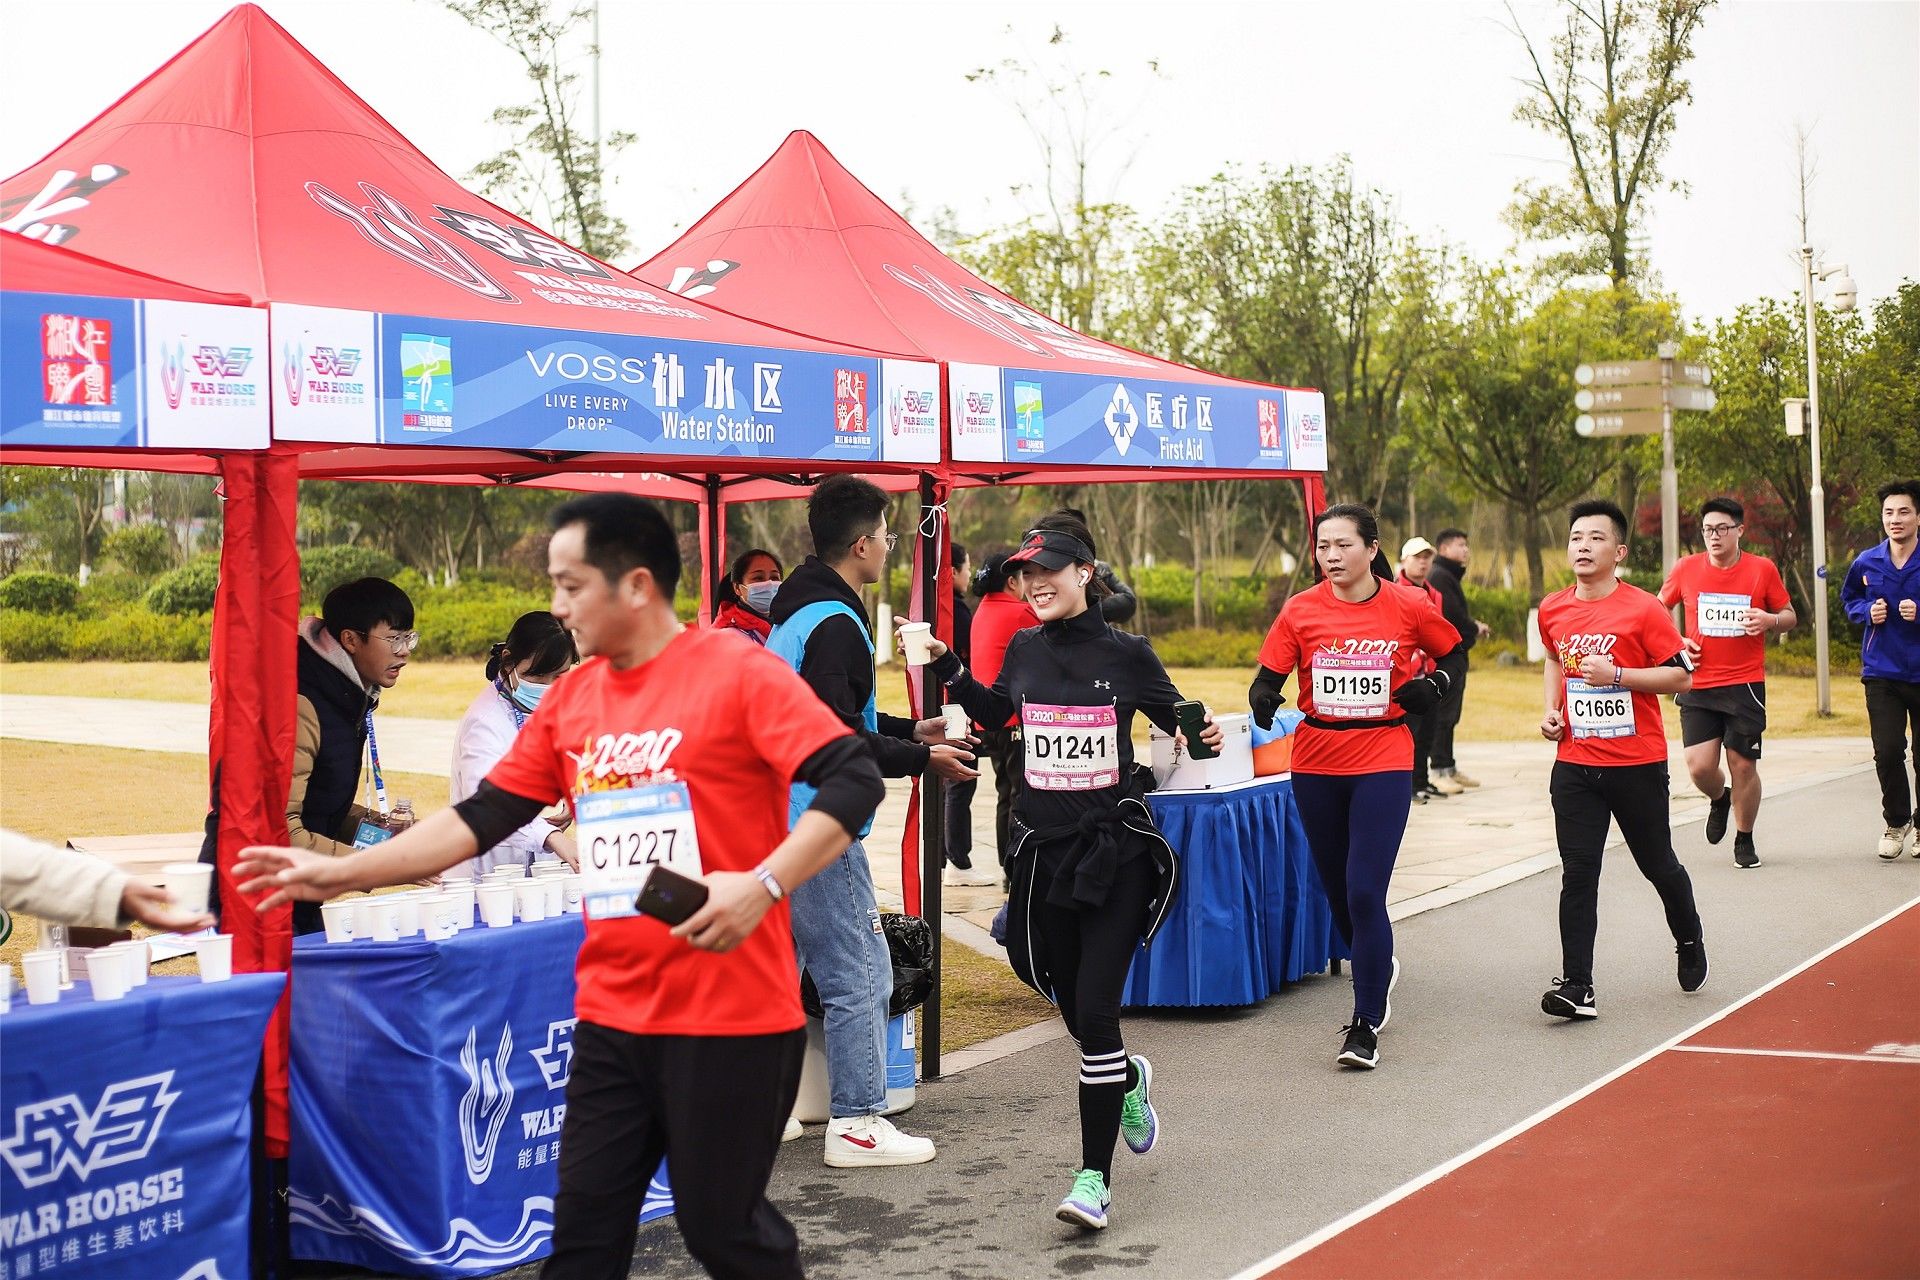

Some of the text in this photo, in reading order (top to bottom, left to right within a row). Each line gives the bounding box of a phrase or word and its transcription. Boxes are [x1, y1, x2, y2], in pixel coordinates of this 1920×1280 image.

[190, 382, 256, 396] WAR HORSE
[308, 380, 364, 394] WAR HORSE
[652, 352, 784, 414] 补水区
[545, 393, 629, 413] LIVE EVERY
[1146, 391, 1213, 431] 医疗区
[661, 411, 775, 444] Water Station
[1159, 436, 1204, 461] First Aid
[1568, 634, 1617, 656] 2020
[1323, 676, 1382, 695] D1195
[1032, 711, 1054, 723] 2020
[1574, 699, 1626, 717] C1666
[592, 727, 684, 779] 2020
[1035, 735, 1106, 759] D1241
[591, 828, 678, 870] C1227
[66, 1168, 184, 1229] HORSE
